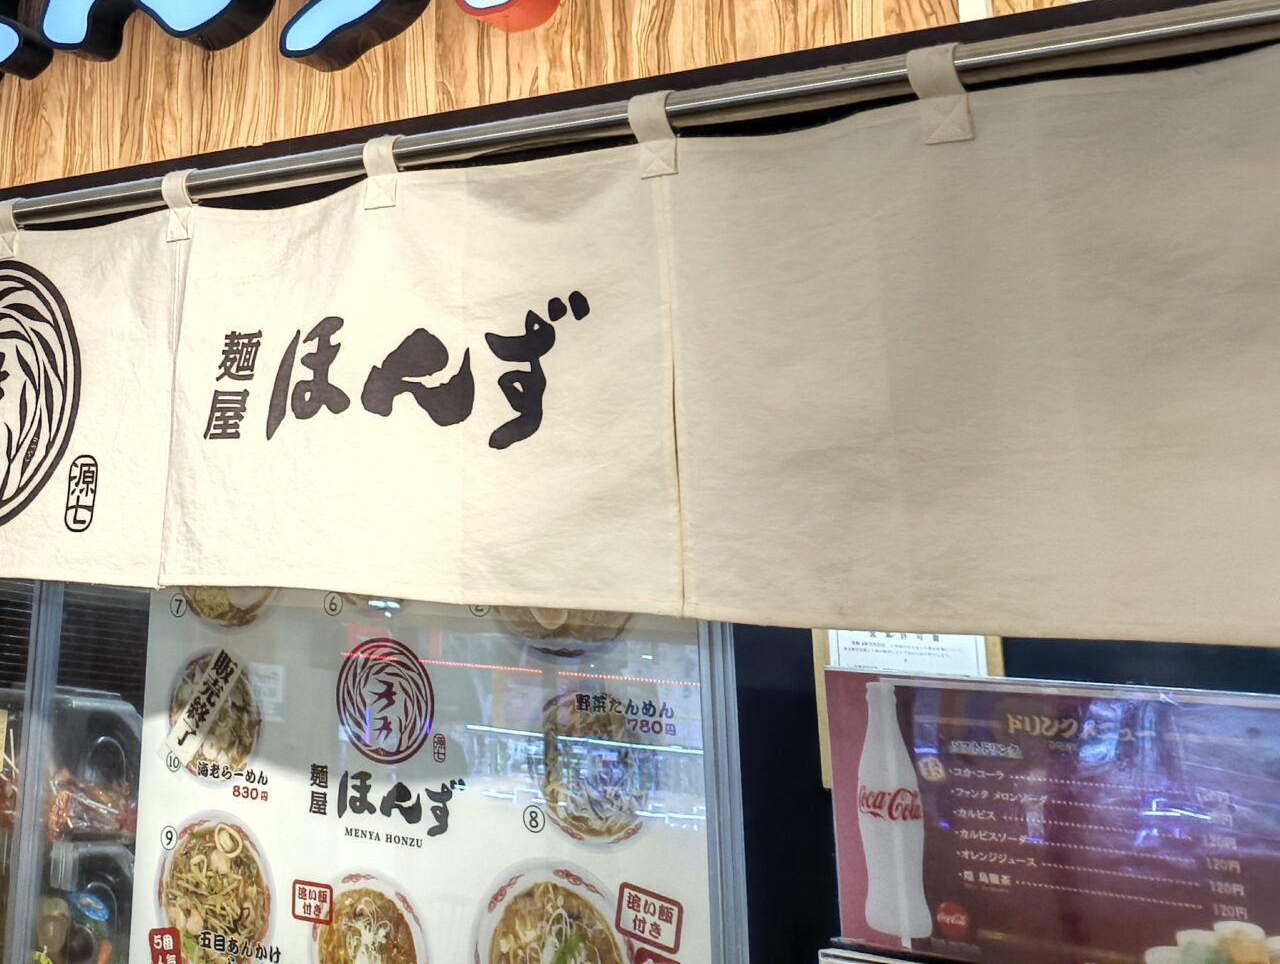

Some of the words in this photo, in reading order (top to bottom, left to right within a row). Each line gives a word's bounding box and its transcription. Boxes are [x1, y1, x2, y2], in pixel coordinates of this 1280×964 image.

[266, 290, 590, 449] ほんず
[203, 330, 263, 440] 麺屋
[70, 462, 95, 528] 源七
[575, 693, 674, 719] 野菜たんめん
[627, 718, 676, 736] 780円
[196, 761, 268, 786] 海老らーめん
[232, 785, 269, 801] 830円
[309, 763, 328, 816] 麺屋
[337, 770, 466, 836] ほんず
[344, 827, 380, 842] MENYA
[385, 833, 423, 848] HONZU
[1206, 857, 1241, 874] 120円
[1209, 879, 1245, 897] 120円
[1214, 903, 1248, 920] 120円
[200, 932, 281, 964] 五目あんかけ
